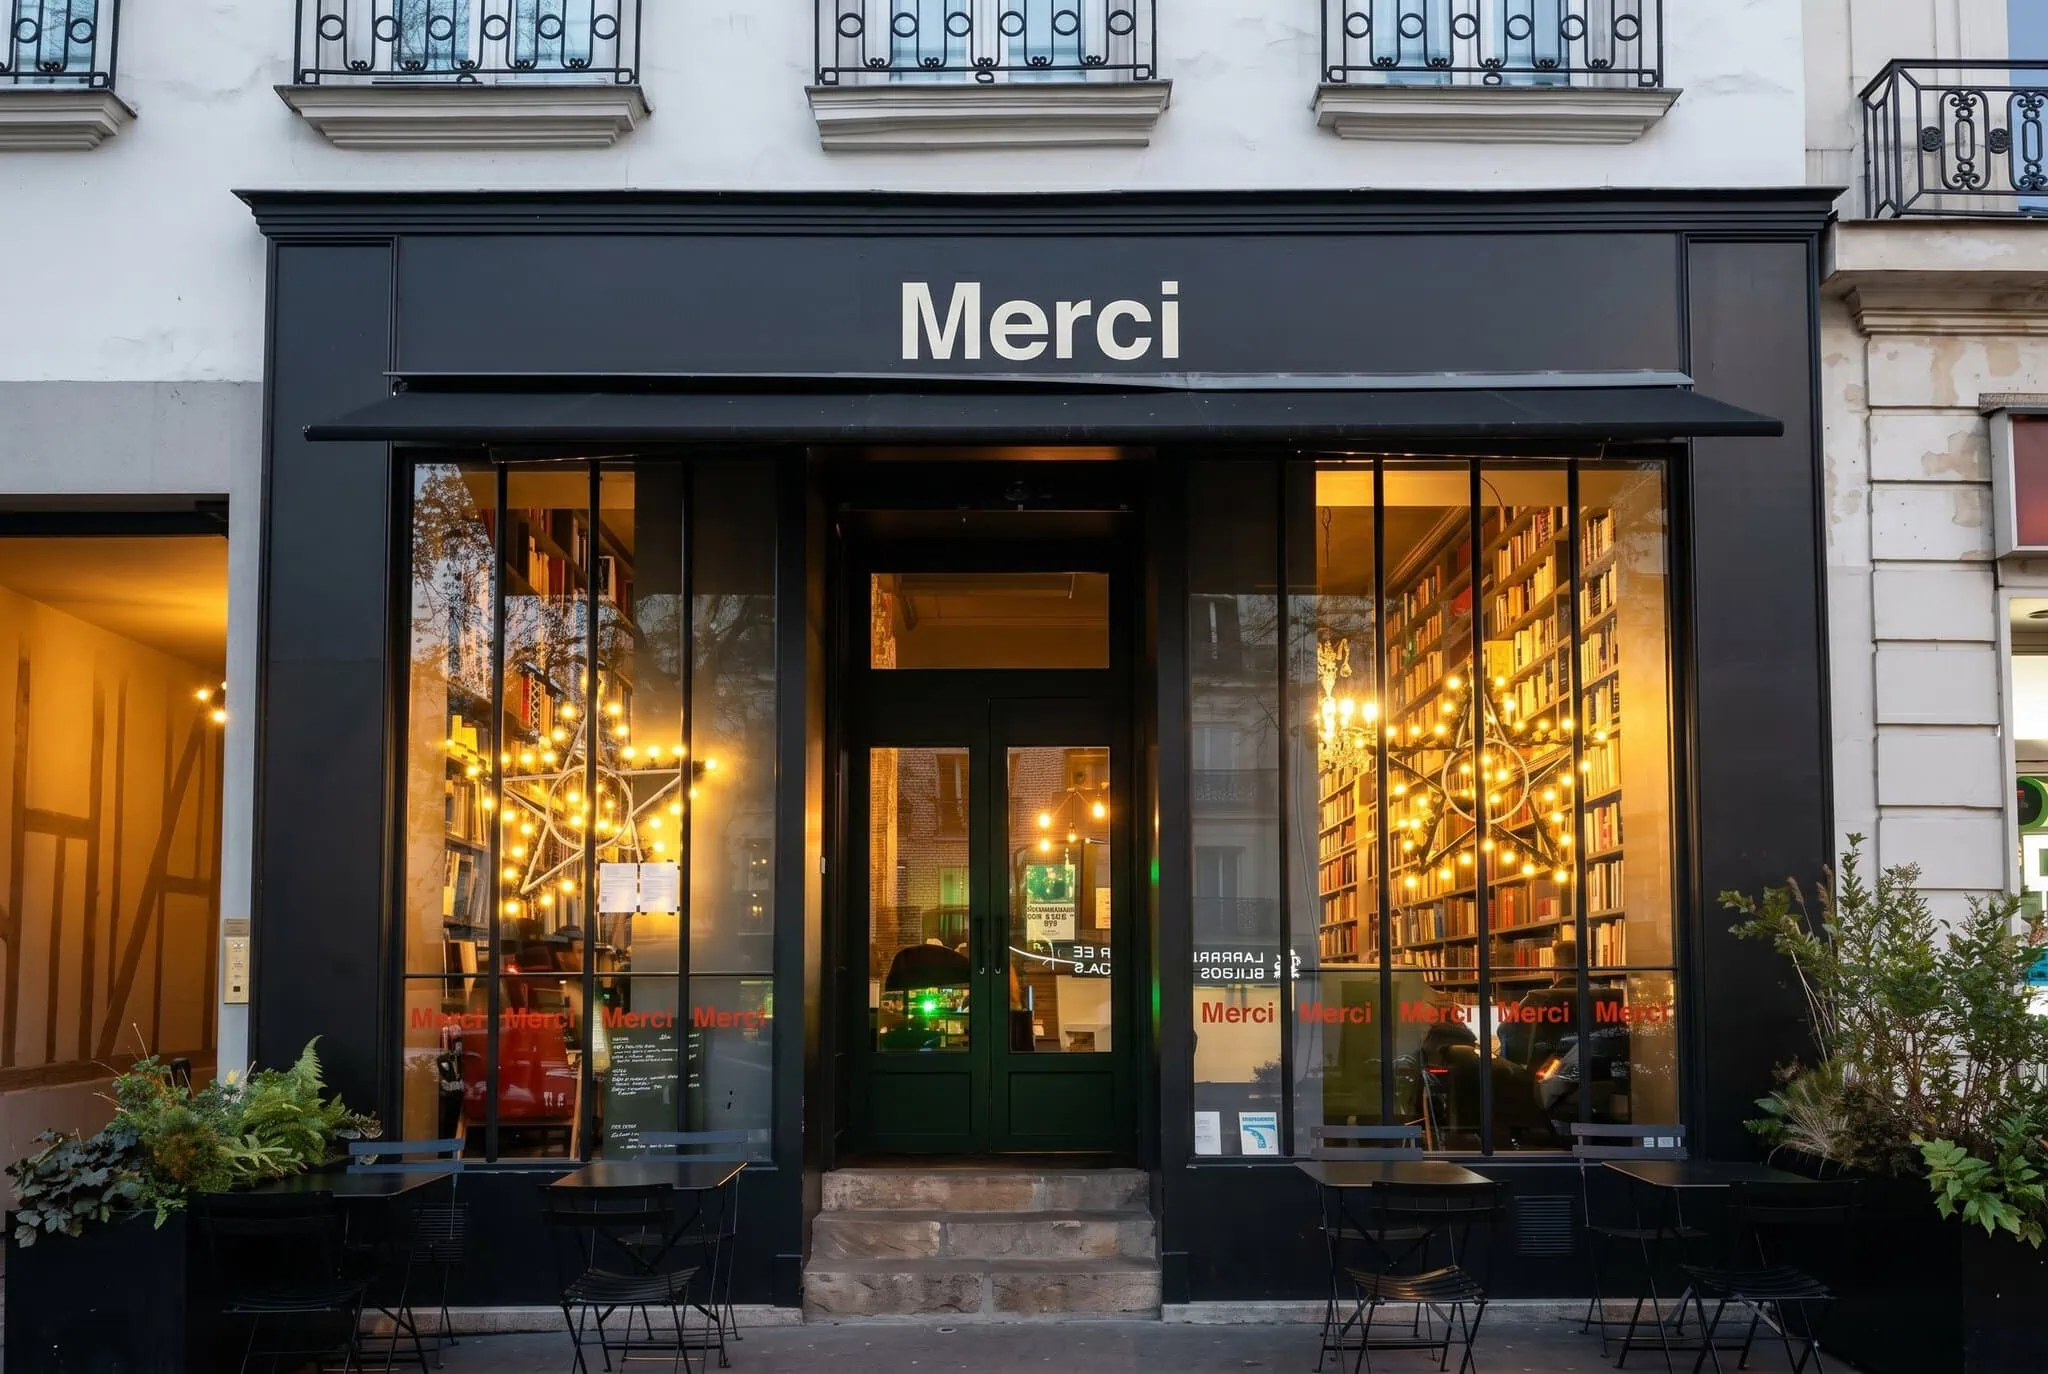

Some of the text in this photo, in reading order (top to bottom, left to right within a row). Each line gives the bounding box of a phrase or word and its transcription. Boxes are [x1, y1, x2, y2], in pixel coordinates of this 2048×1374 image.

[902, 281, 1179, 360] Merci
[411, 1007, 485, 1029] Merci
[505, 1006, 575, 1029] Merci
[602, 1006, 672, 1029] Merci
[694, 1005, 768, 1029] Merci
[1202, 1002, 1273, 1023] Merci
[1300, 1001, 1371, 1023] Merci
[1400, 1001, 1472, 1023] Merci
[1497, 1001, 1569, 1023] Merci
[1596, 1001, 1668, 1023] Merci
